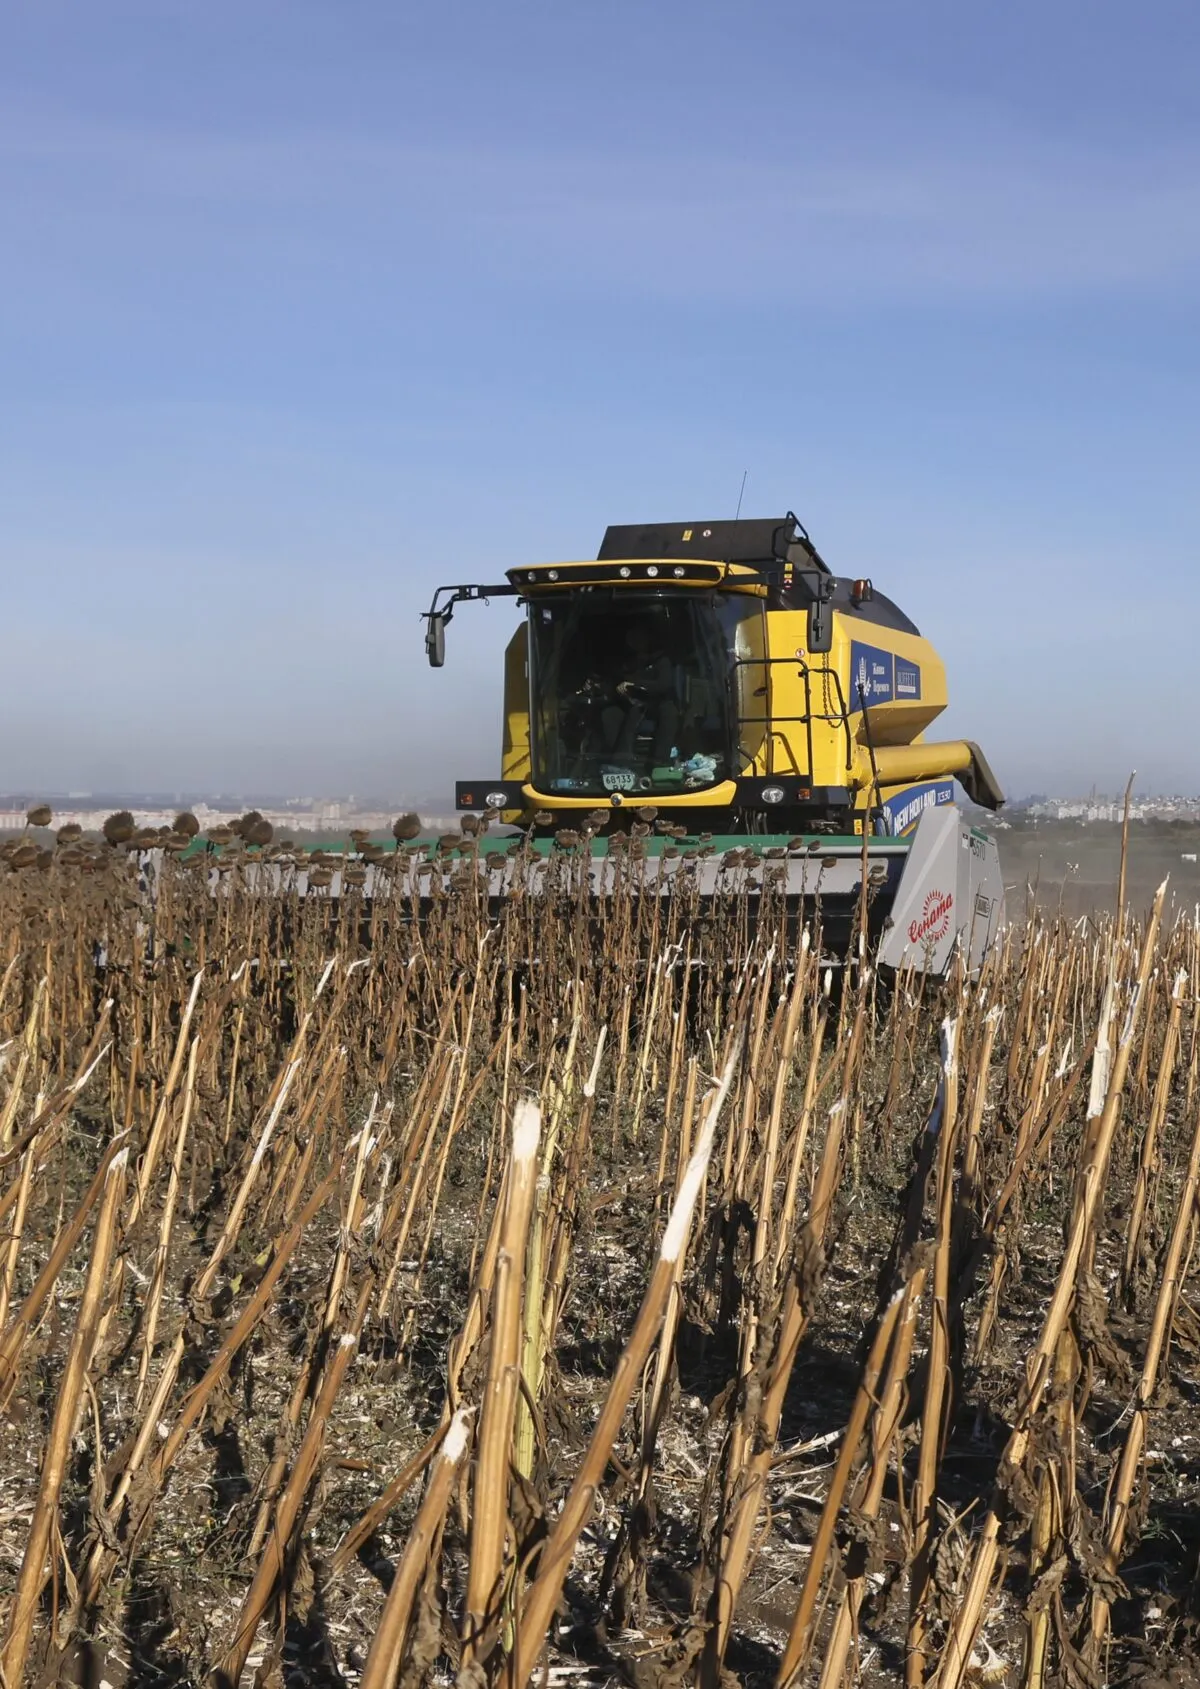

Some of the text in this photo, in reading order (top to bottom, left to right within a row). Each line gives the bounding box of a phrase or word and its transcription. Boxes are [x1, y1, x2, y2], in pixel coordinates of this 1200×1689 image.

[606, 774, 632, 784] 68133
[894, 805, 909, 837] NEW
[909, 789, 936, 822] HOLLAND
